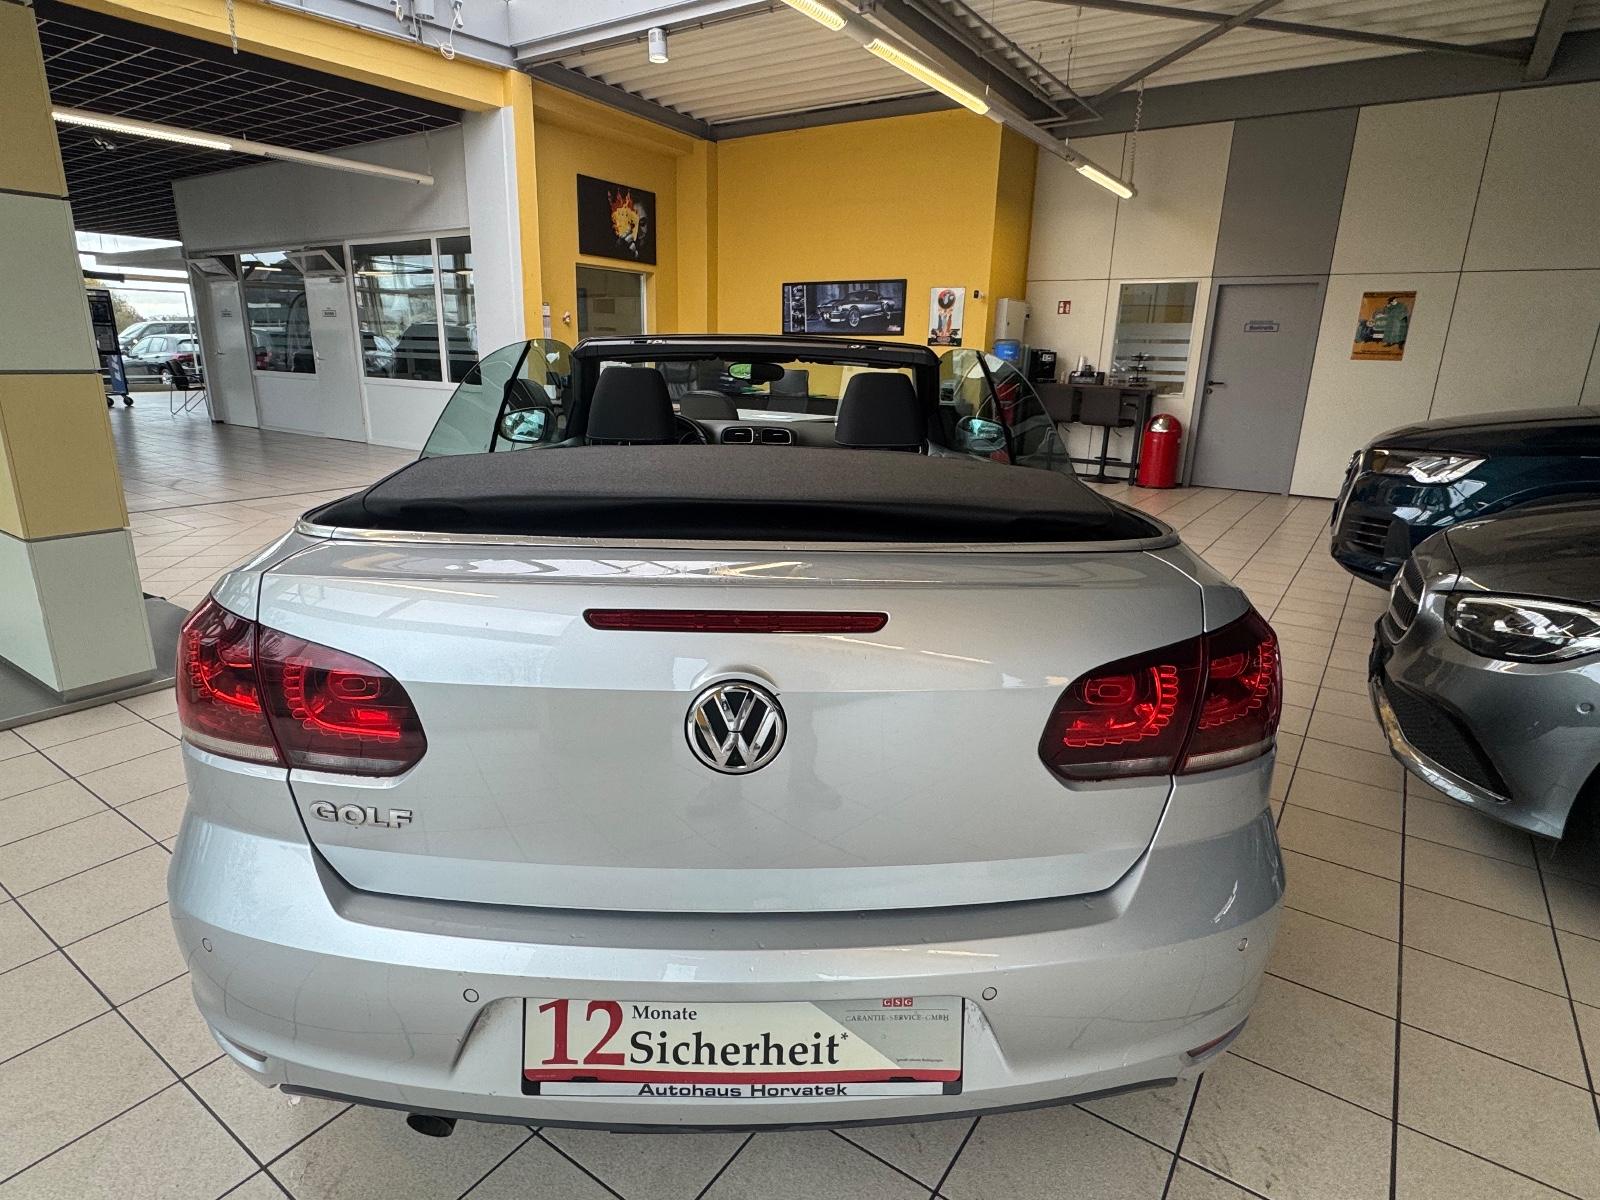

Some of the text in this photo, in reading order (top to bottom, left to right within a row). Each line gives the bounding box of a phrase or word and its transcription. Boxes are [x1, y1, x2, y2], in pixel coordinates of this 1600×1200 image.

[310, 800, 412, 828] GOLF
[883, 998, 913, 1007] GSG
[632, 1005, 697, 1020] Monate
[538, 999, 625, 1065] 12
[639, 1083, 848, 1097] Autohaus Horvatek
